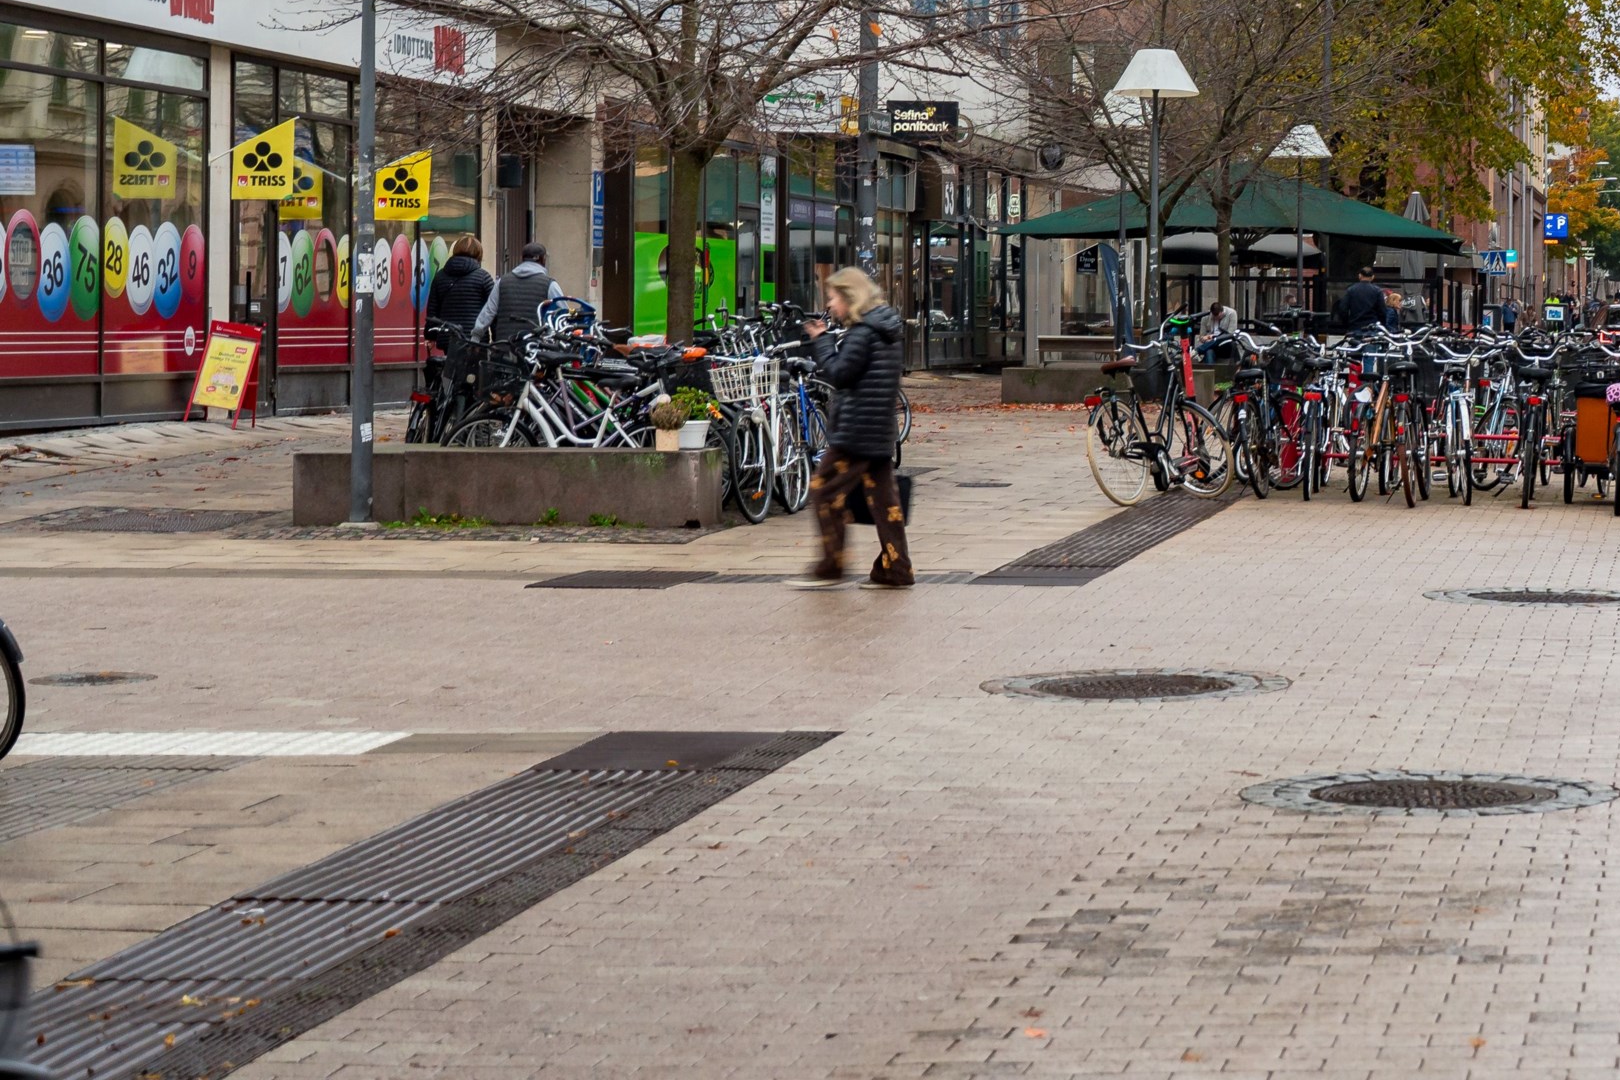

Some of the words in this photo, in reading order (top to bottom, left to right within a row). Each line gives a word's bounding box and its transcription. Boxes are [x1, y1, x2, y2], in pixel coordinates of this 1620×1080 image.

[393, 33, 434, 61] IDROTTENS
[893, 109, 928, 120] Sefina
[893, 121, 949, 133] pantbank
[250, 175, 286, 187] TRISS
[388, 197, 421, 208] TRISS
[1557, 219, 1566, 230] P
[42, 250, 64, 296] 36
[75, 243, 97, 294] 75
[105, 241, 123, 276] 28
[132, 252, 150, 289] 46
[157, 248, 178, 295] 32
[187, 250, 197, 281] 9
[278, 255, 287, 289] 7
[294, 253, 311, 296] 62
[376, 257, 389, 290] 55
[397, 258, 405, 288] 8
